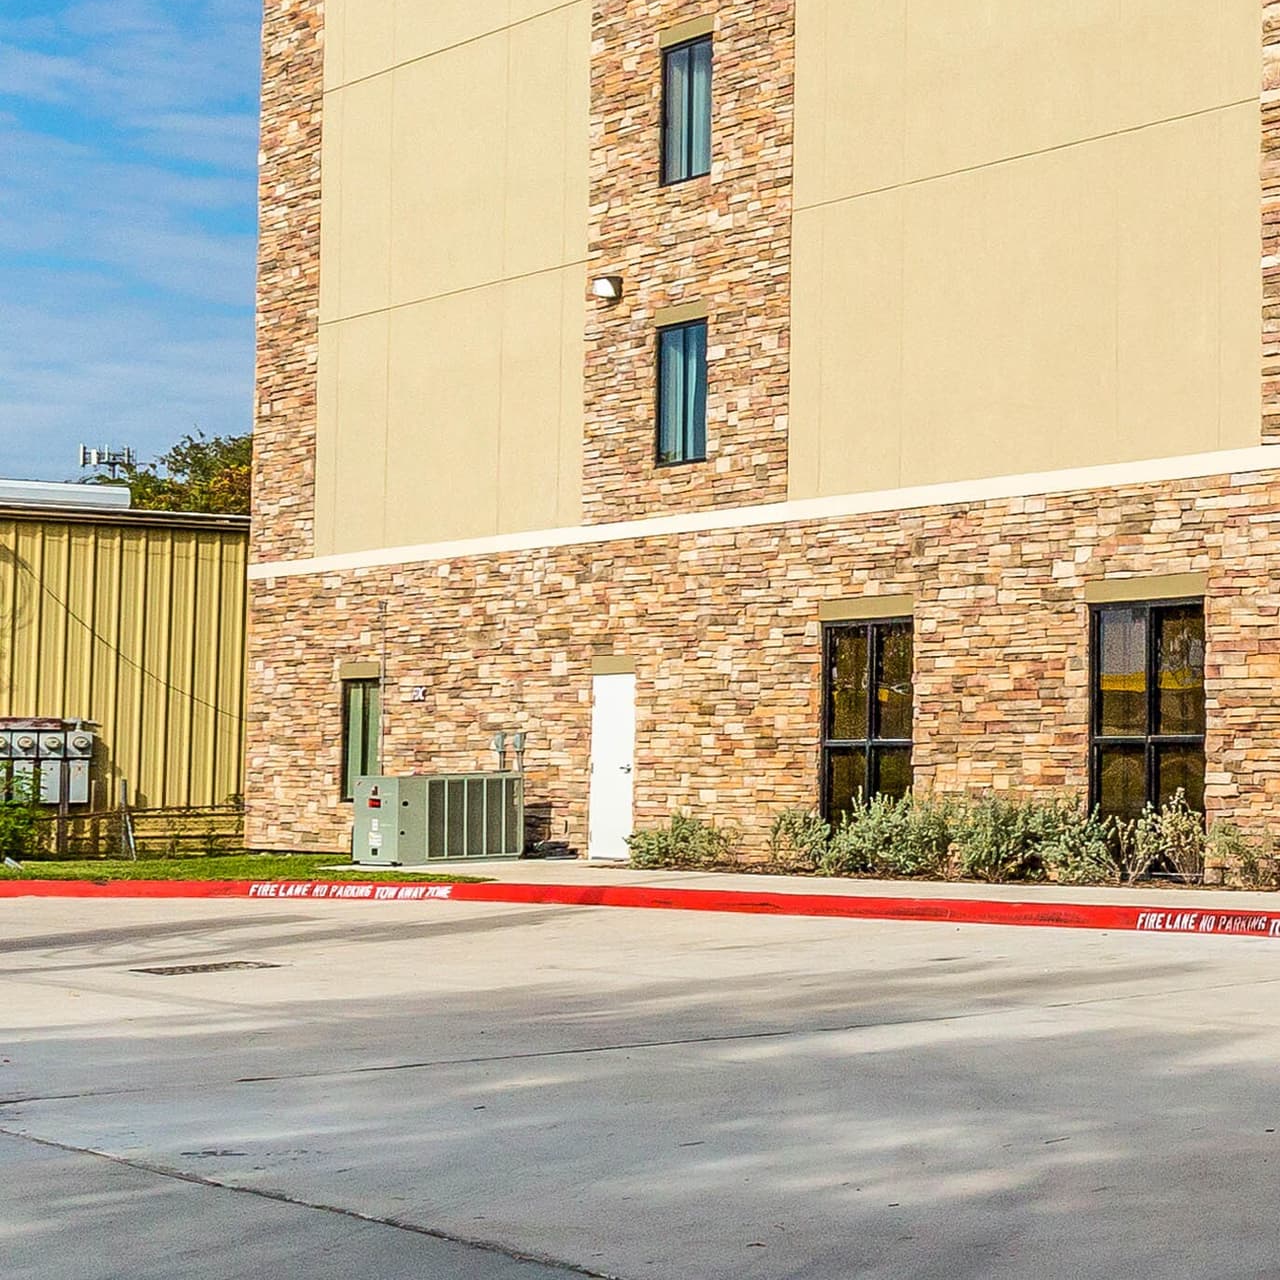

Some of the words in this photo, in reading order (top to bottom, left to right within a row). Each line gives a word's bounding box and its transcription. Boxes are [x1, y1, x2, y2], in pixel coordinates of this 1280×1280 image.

[248, 884, 278, 897] FIRE
[278, 884, 311, 897] LANE
[312, 884, 329, 897] NO
[329, 885, 374, 897] PARKING
[374, 886, 399, 899] TOW
[397, 886, 427, 899] AWAY
[425, 886, 453, 898] ZONE
[1136, 912, 1165, 930] FIRE
[1165, 913, 1197, 930] LANE
[1199, 914, 1216, 932] NO
[1217, 916, 1267, 932] PARKING
